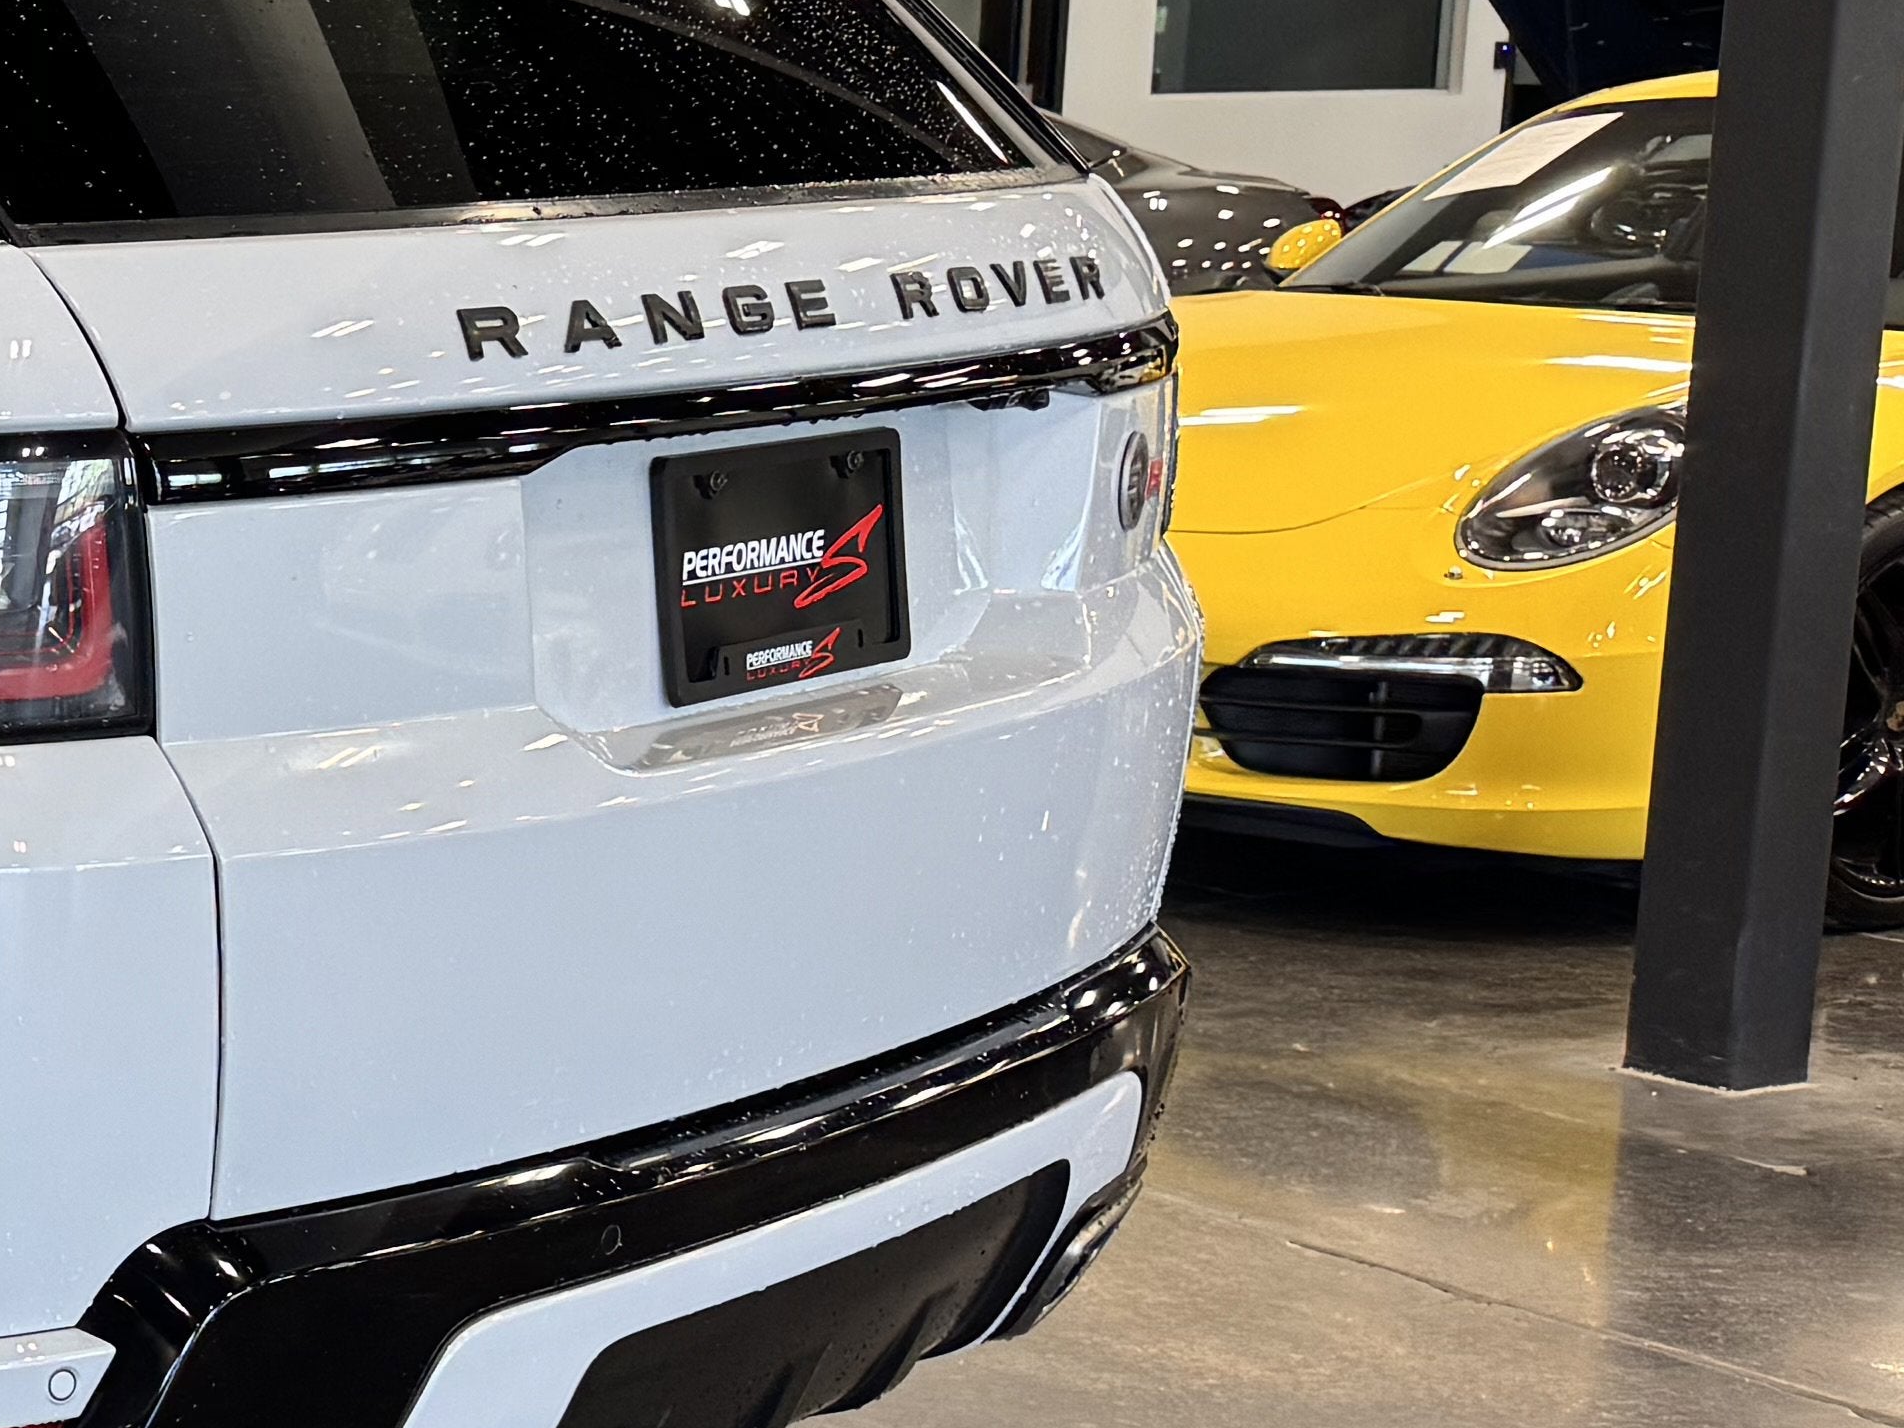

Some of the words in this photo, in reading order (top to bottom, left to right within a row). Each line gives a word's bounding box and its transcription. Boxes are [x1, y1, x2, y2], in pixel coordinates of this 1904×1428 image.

[456, 278, 838, 362] RANGE
[890, 254, 1107, 320] ROVER
[682, 528, 826, 581] PERFORMANCE
[680, 566, 822, 608] LUXURY
[746, 639, 814, 671] PERFORMANCE
